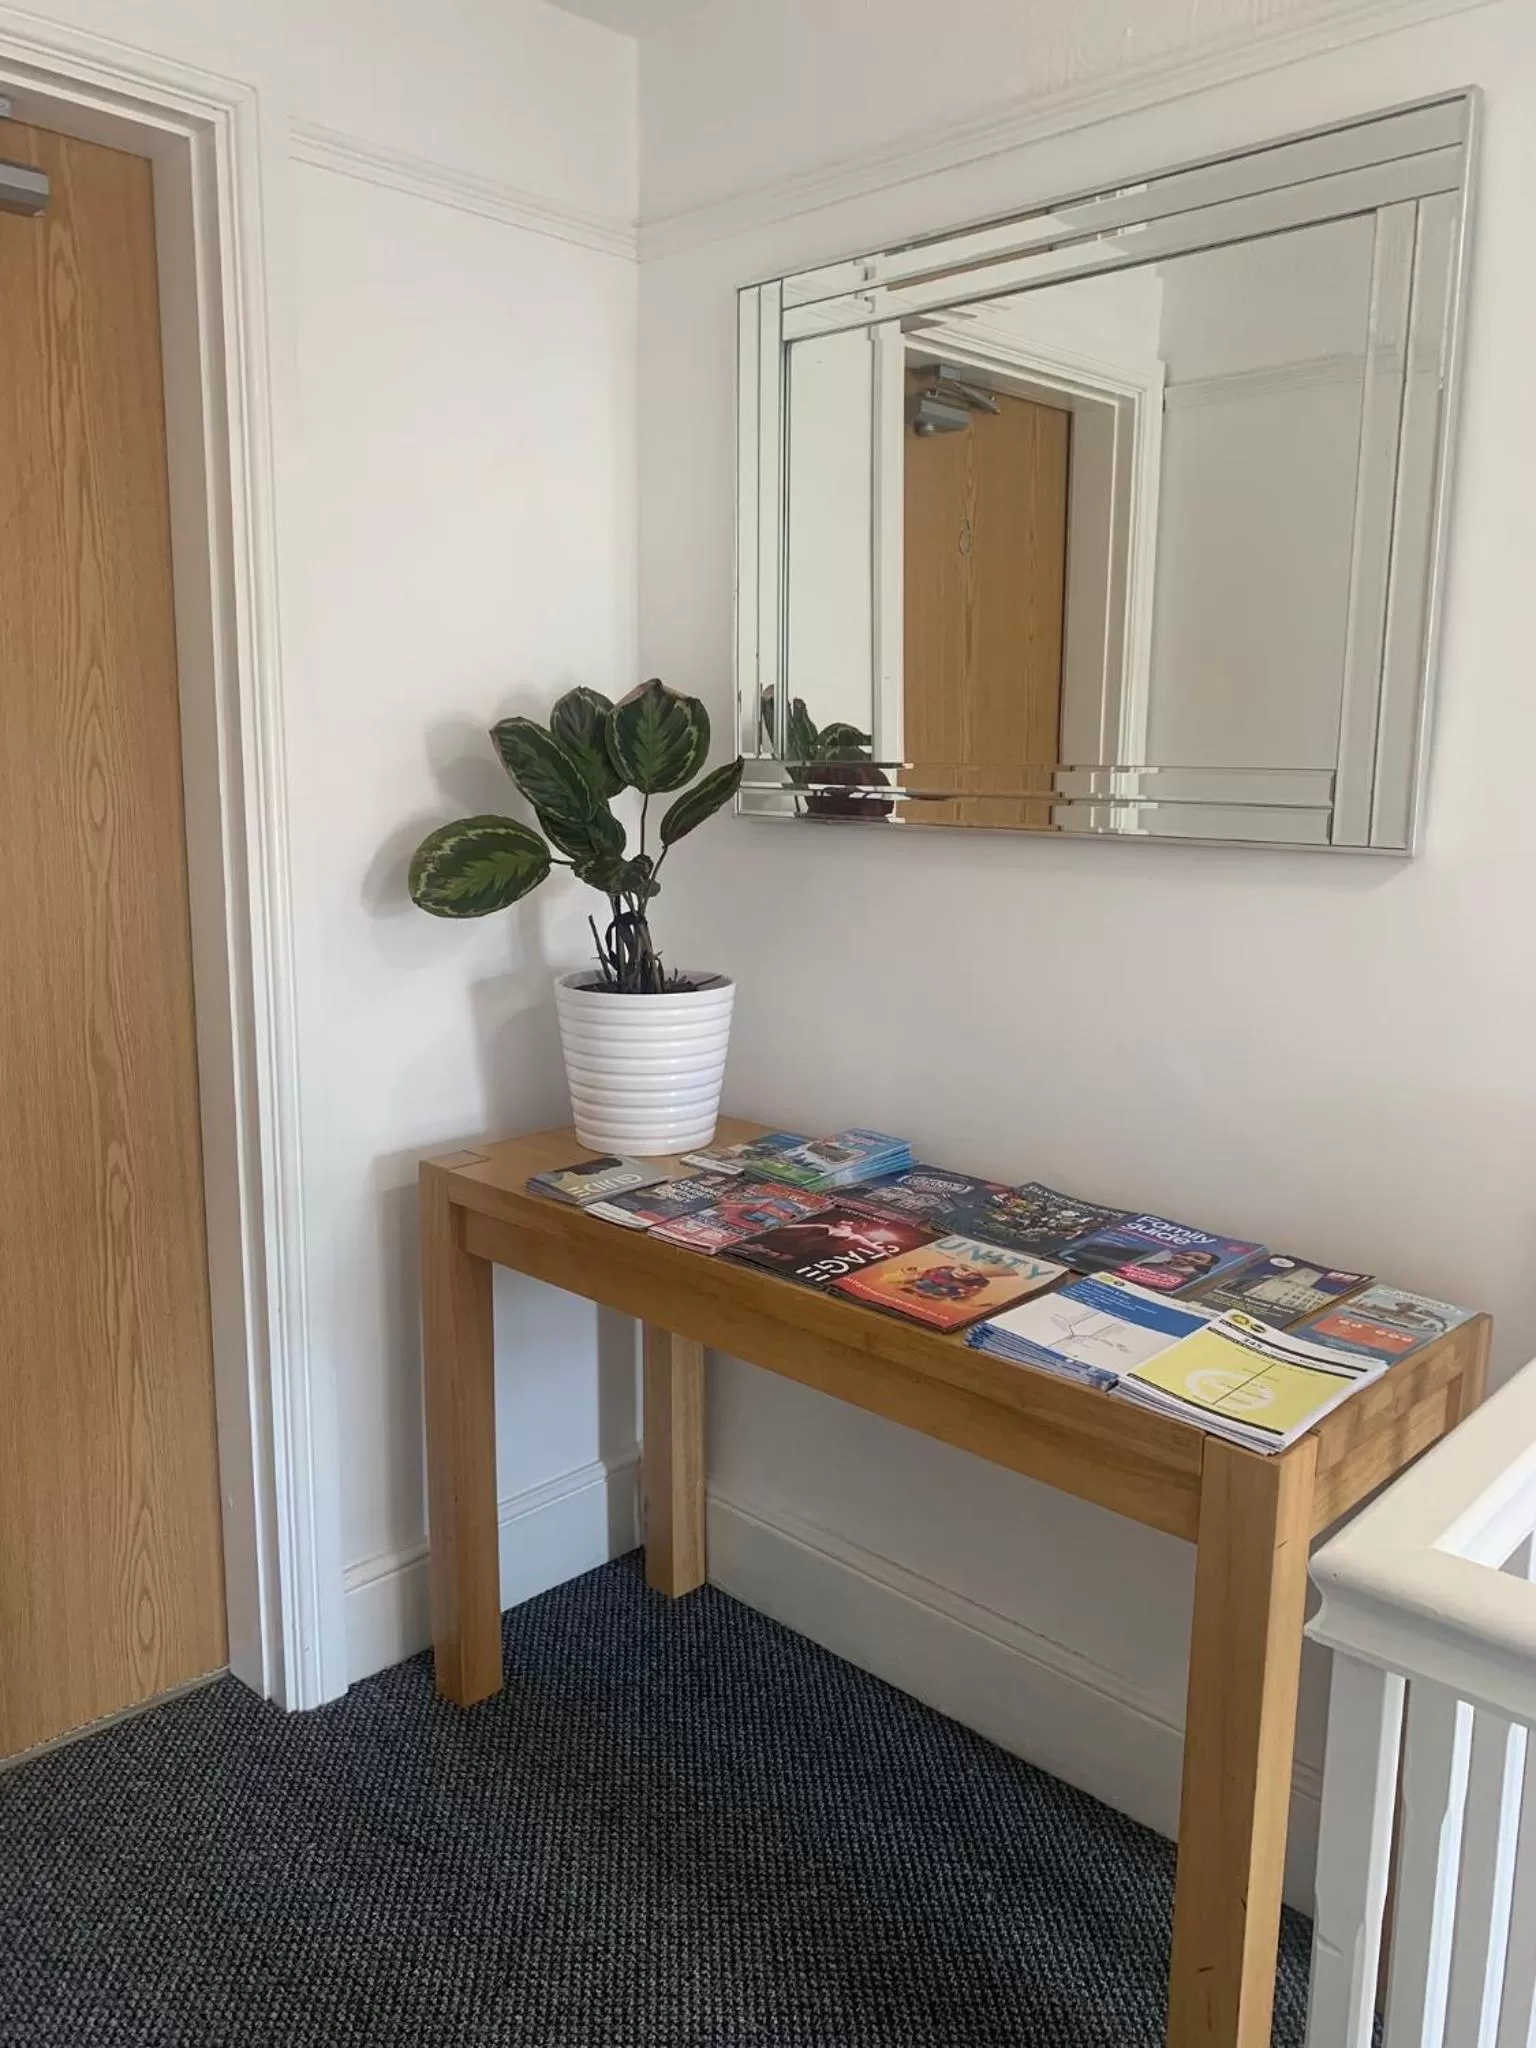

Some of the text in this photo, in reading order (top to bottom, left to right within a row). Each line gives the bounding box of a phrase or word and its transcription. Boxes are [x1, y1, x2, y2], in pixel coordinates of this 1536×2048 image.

[567, 1173, 643, 1198] GUIDE
[1121, 1222, 1191, 1245] guide
[1135, 1215, 1217, 1244] Family
[795, 1241, 900, 1281] STAGE
